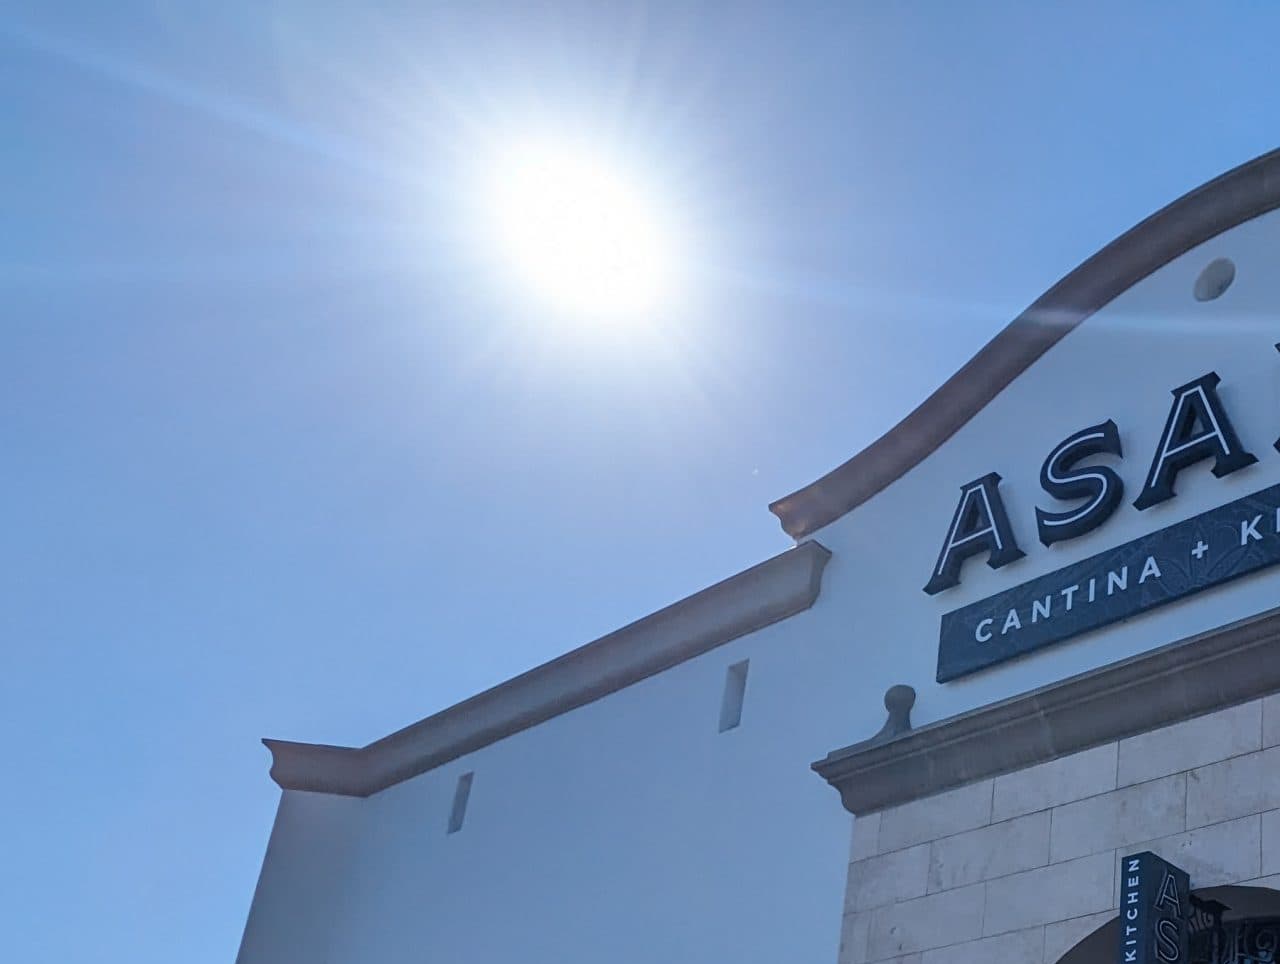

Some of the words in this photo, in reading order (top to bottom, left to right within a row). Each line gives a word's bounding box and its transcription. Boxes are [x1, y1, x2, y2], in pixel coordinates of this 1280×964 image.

[974, 556, 1162, 643] CANTINA
[1190, 540, 1209, 559] +
[1124, 858, 1140, 962] KITCHEN
